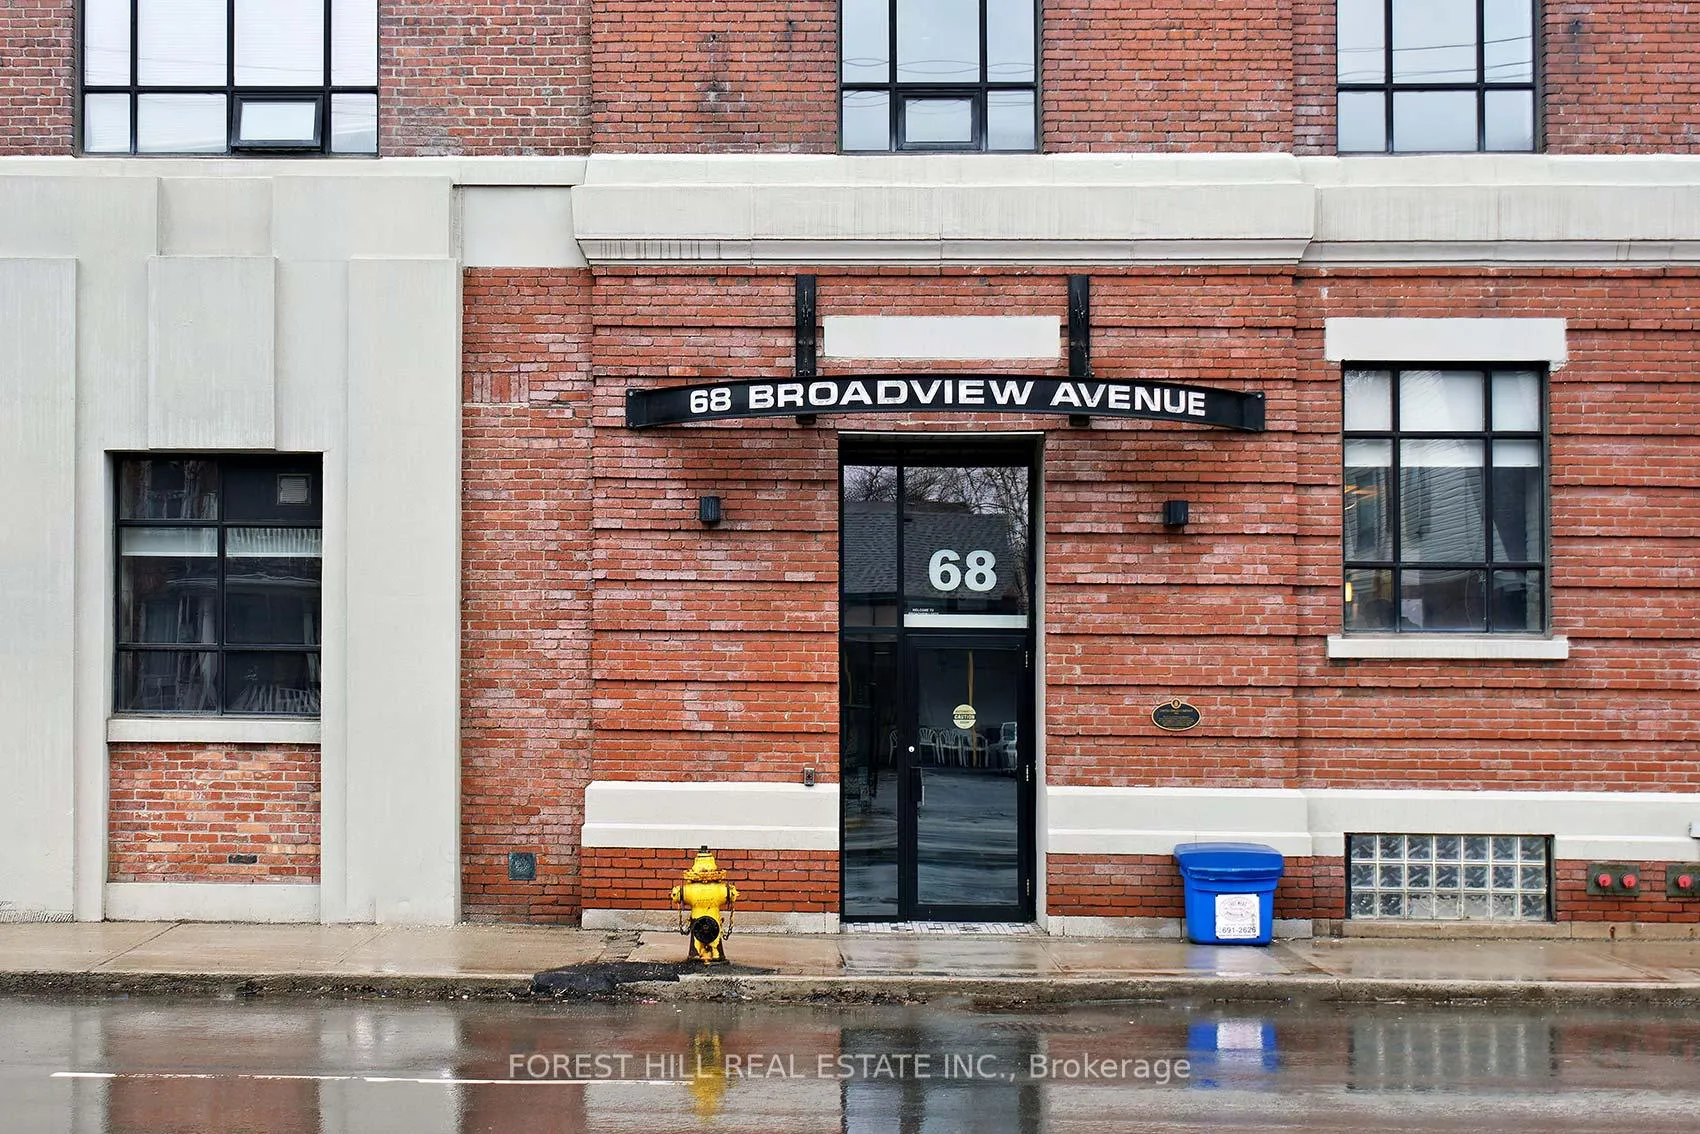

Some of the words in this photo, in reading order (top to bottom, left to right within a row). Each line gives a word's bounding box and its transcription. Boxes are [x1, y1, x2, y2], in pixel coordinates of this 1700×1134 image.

[690, 387, 731, 413] 68
[749, 380, 1034, 409] BROADVIEW
[1050, 382, 1206, 416] AVENUE
[928, 549, 997, 592] 68
